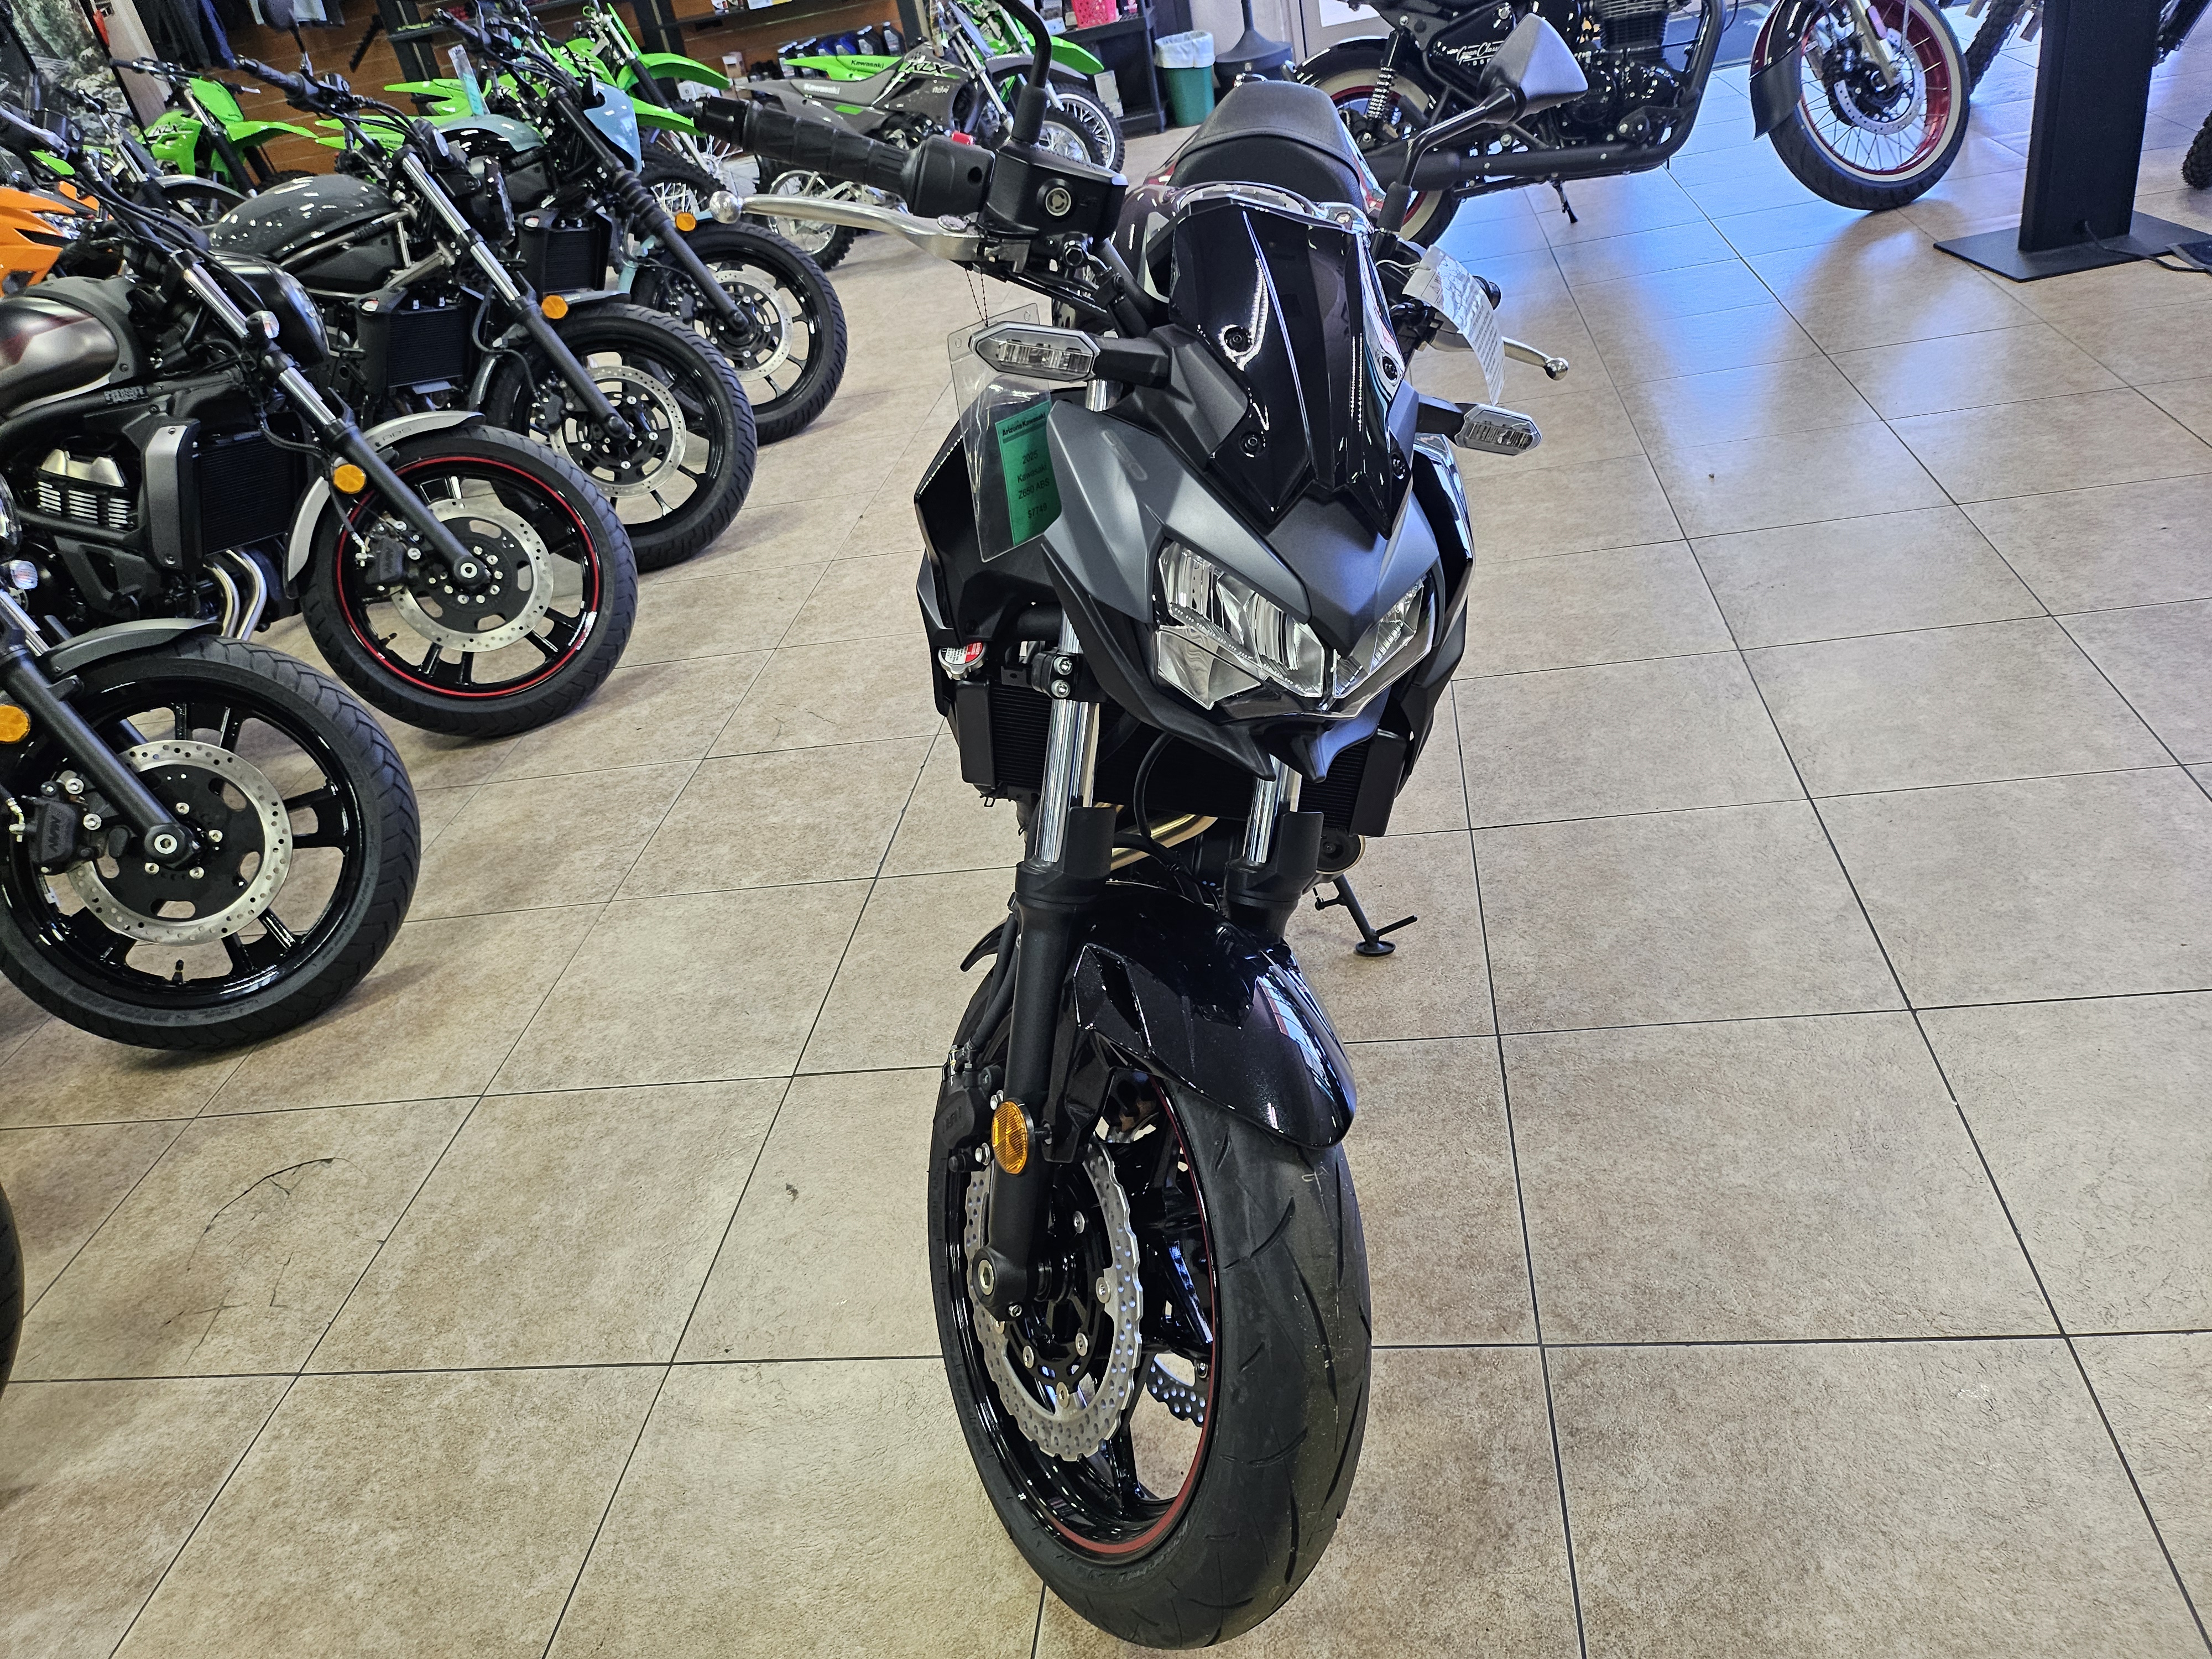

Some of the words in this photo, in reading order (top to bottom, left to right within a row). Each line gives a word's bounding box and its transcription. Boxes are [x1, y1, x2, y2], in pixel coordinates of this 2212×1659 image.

[851, 60, 884, 69] Kawasaki
[904, 60, 956, 76] KLX
[804, 82, 841, 95] Kawasaki
[1003, 423, 1022, 436] Arizona
[1022, 412, 1046, 427] Kawasaki
[1021, 450, 1039, 465] 2025
[1016, 463, 1047, 484] Kawasaki
[1018, 485, 1035, 500] Z650
[1036, 477, 1050, 491] ABS
